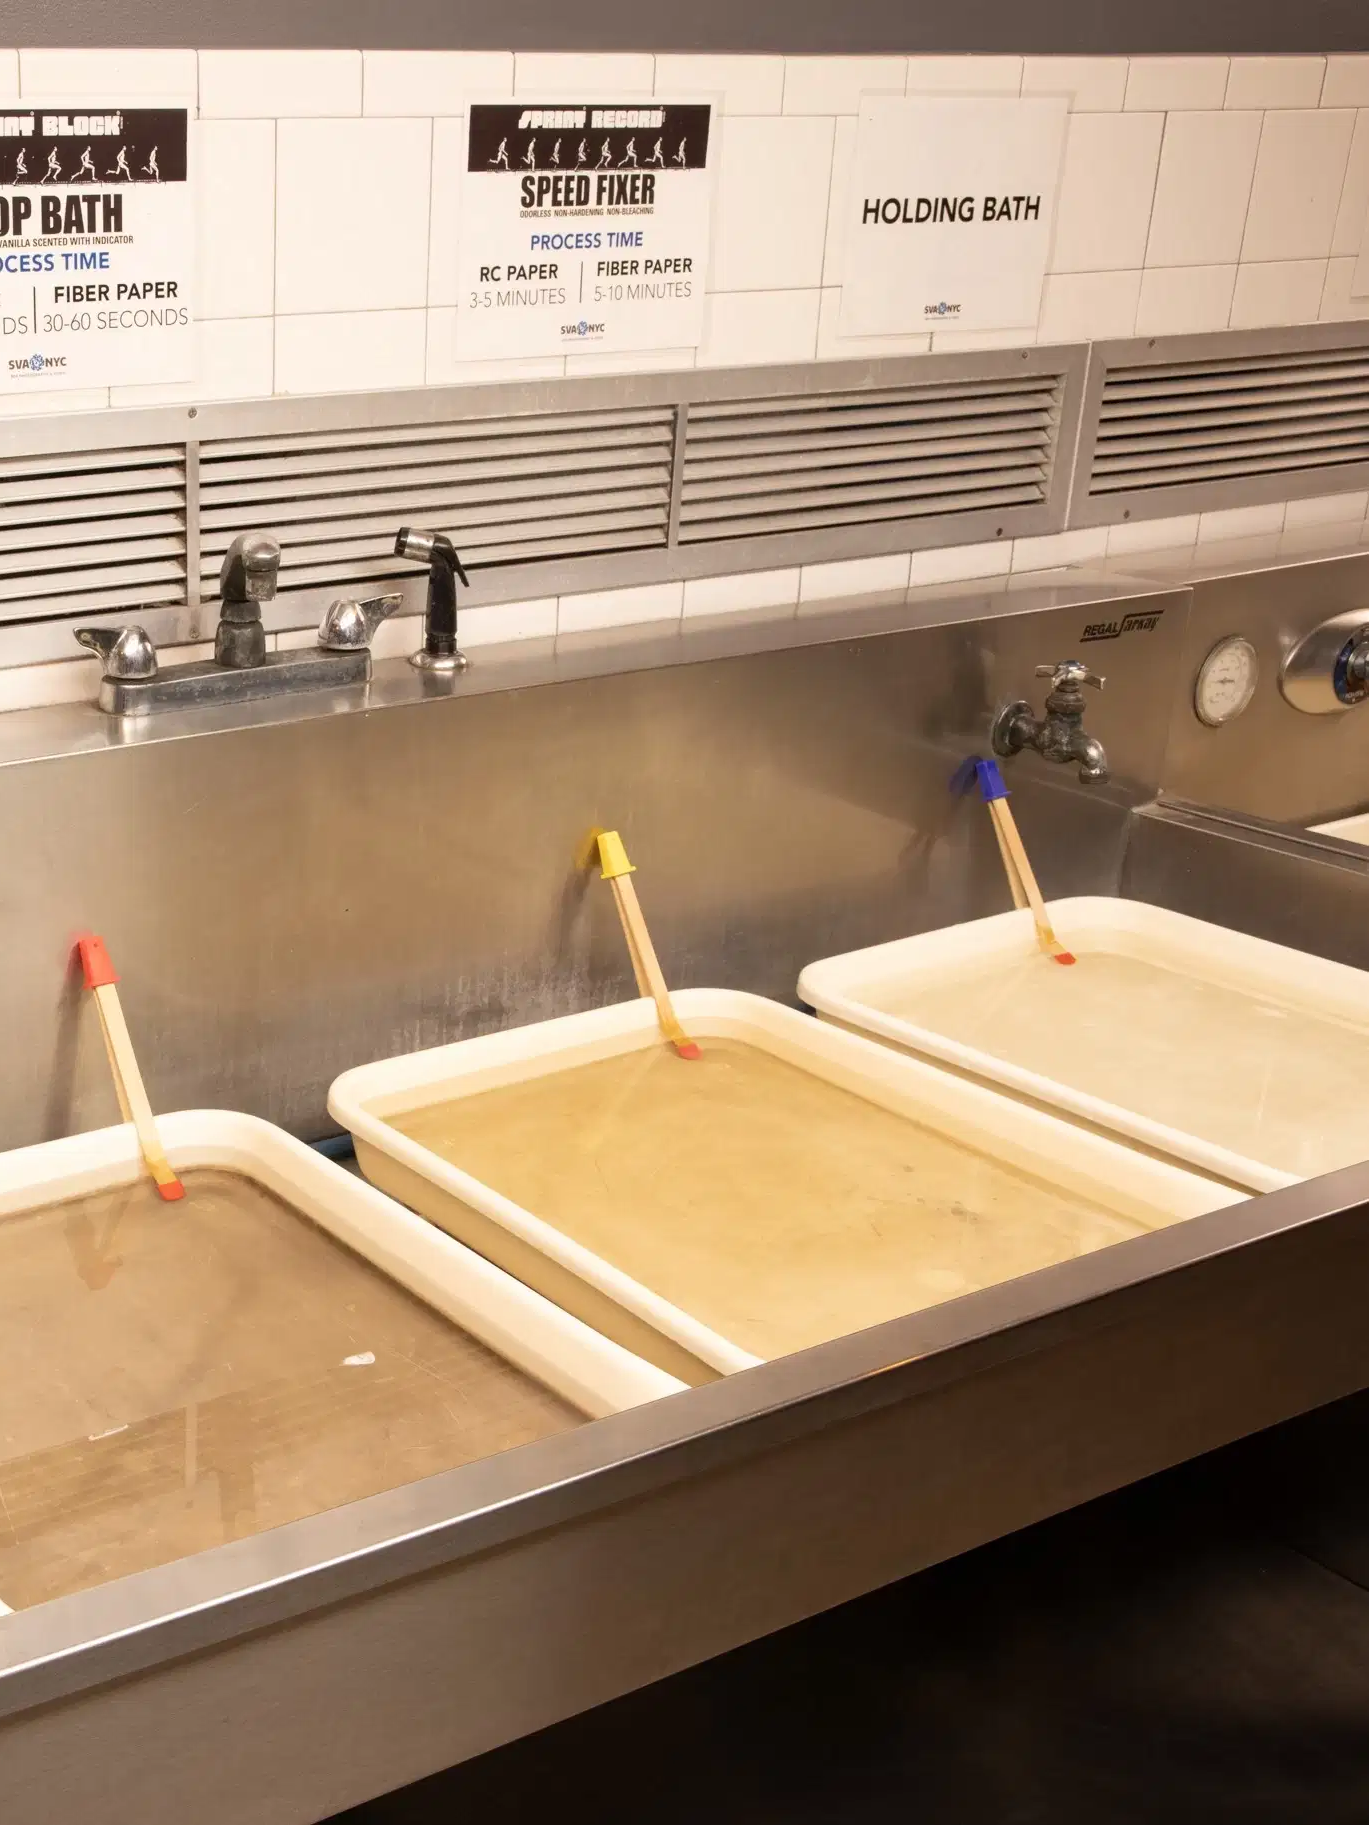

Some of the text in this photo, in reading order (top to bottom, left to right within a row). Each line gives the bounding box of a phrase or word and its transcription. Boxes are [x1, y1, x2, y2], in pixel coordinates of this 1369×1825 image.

[42, 115, 121, 136] BLOCK
[518, 109, 664, 129] SPRINT RECORD
[520, 173, 656, 208] SPEED FIXER
[41, 194, 123, 235] BATH
[520, 206, 654, 218] ODORLESS NON-HARDENING NON-BLEACHING
[862, 195, 1041, 224] HOLDING BATH
[32, 237, 68, 247] SCENTED
[69, 236, 91, 245] WITH
[92, 235, 134, 245] INDICATOR
[531, 231, 644, 251] PROCESS TIME
[61, 252, 110, 271] TIME
[597, 258, 693, 276] FIBER PAPER
[480, 263, 559, 282] RC PAPER
[54, 281, 179, 303] FIBER PAPER
[469, 287, 566, 308] 3-5 MINUTES
[594, 281, 692, 302] 5-10 MINUTES
[924, 304, 961, 314] SVA NYC
[43, 307, 189, 333] 30-60 SECONDS
[560, 323, 605, 335] SVA NYC
[8, 357, 67, 370] SVA NYC
[1083, 622, 1118, 636] REGAL
